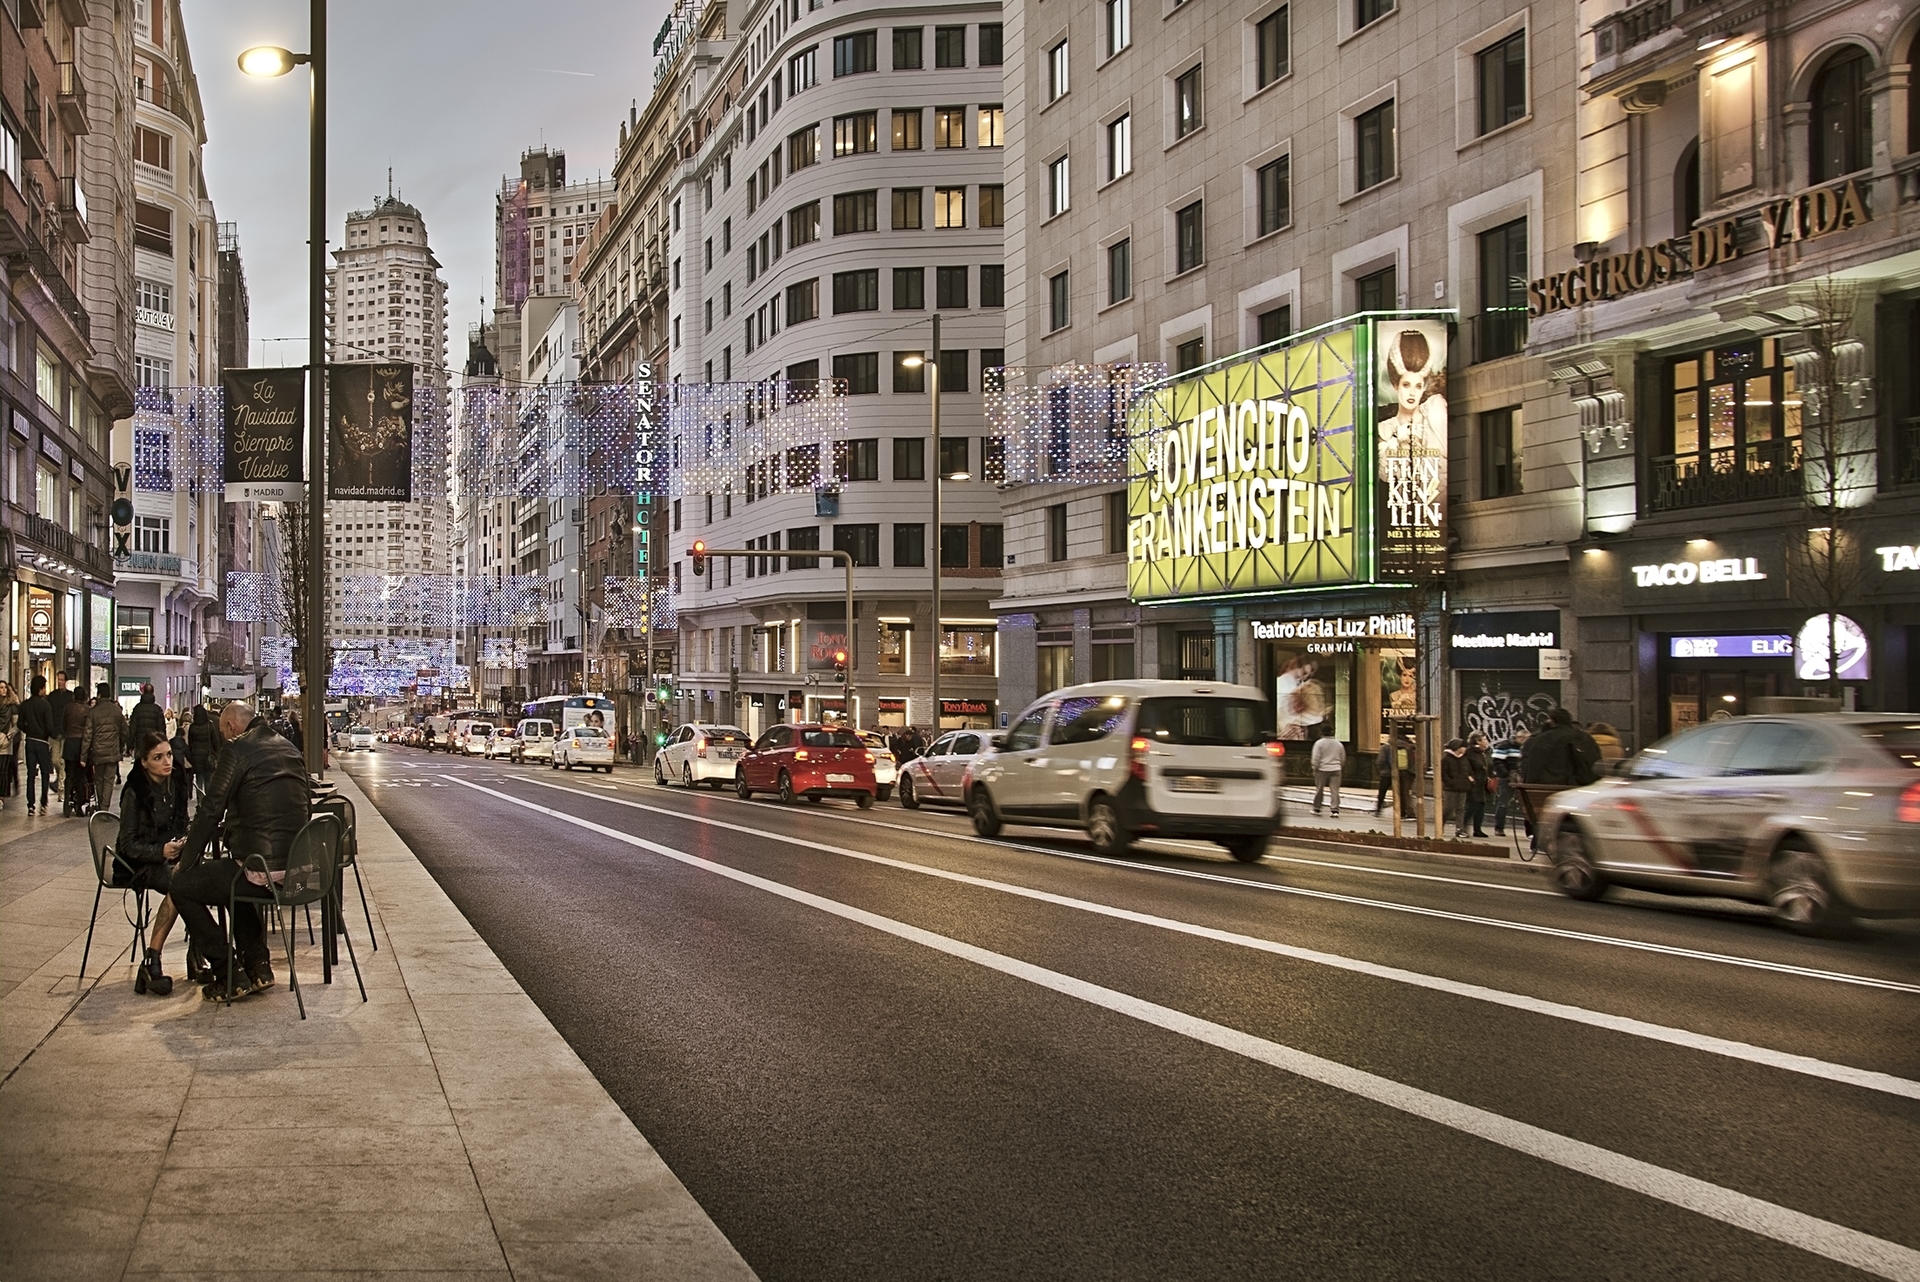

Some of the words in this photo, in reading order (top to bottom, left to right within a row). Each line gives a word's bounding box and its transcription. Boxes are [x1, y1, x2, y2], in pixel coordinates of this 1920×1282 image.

[1528, 238, 1676, 319] SEGUROS
[1689, 218, 1739, 273] DE
[1761, 177, 1874, 249] VIDA
[253, 378, 275, 404] La
[232, 404, 297, 431] Navidad
[636, 363, 652, 482] SENATOR
[234, 430, 294, 457] Siempre
[1150, 398, 1310, 503] JOVENCITO
[238, 456, 290, 479] Vuelve
[254, 488, 284, 497] MADRID
[334, 485, 406, 496] navidad.madrid.es
[1128, 477, 1341, 564] FRANKENSTEIN
[1875, 545, 1920, 572] TA
[1632, 562, 1698, 588] TACO
[1699, 557, 1767, 583] BELL
[1251, 619, 1297, 640] Teatro
[1297, 618, 1316, 639] de
[1319, 617, 1334, 638] la
[1337, 617, 1366, 637] Luz
[1506, 632, 1554, 647] Madrid
